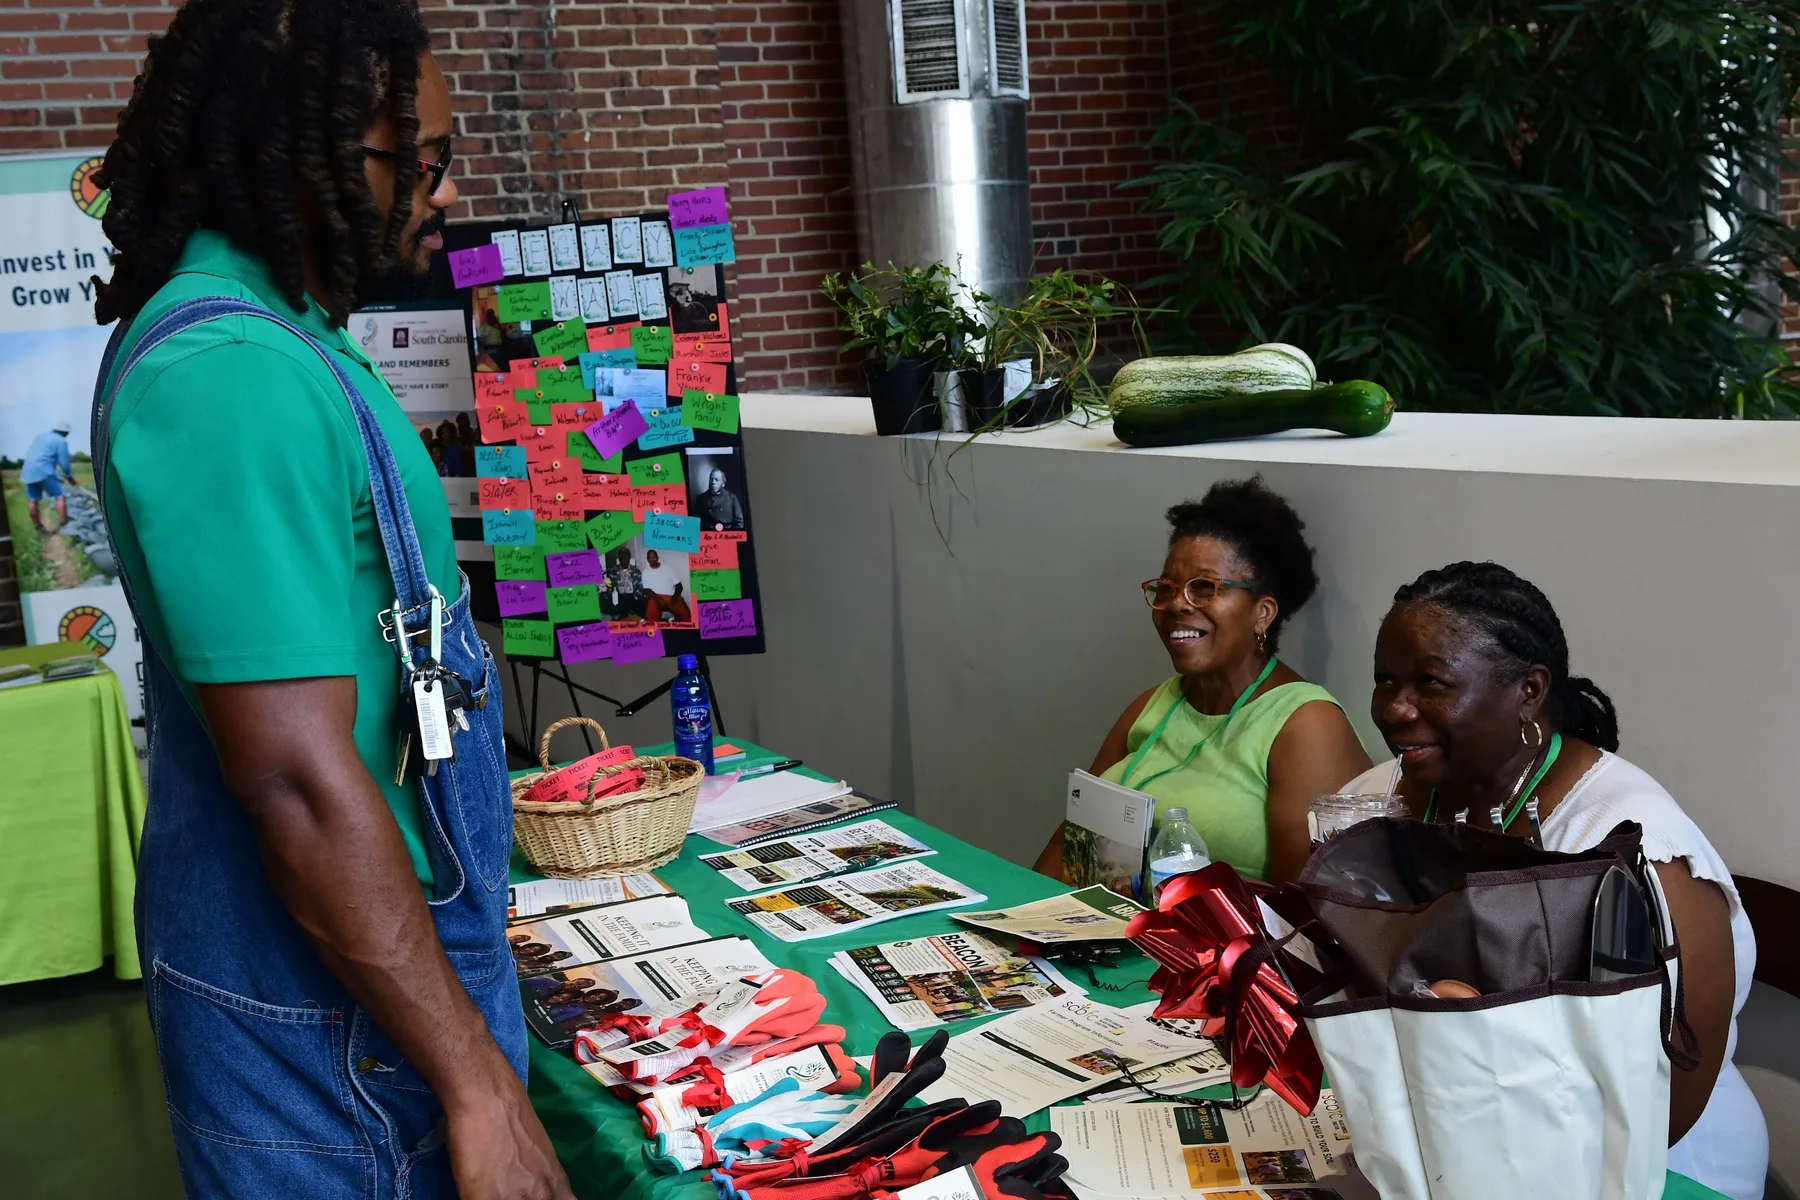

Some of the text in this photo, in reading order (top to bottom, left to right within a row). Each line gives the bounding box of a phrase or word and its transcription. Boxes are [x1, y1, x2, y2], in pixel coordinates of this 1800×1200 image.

[75, 248, 95, 268] in
[12, 286, 69, 306] Grow
[412, 332, 467, 345] South Carolin
[398, 359, 450, 368] REMEMBERS
[676, 369, 712, 384] Frankie
[692, 400, 728, 415] Wright
[694, 412, 722, 428] Family
[632, 488, 656, 496] Prince
[664, 497, 685, 510] Legree
[536, 507, 580, 520] Mary Legree
[678, 707, 708, 721] Callaway
[597, 752, 614, 762] TICKET
[568, 762, 588, 775] TICKET
[541, 776, 560, 790] TICKET
[614, 916, 643, 939] KEEPING
[605, 922, 621, 933] THE
[615, 933, 640, 953] FAMILY
[940, 934, 988, 968] BEACON
[673, 964, 692, 976] THE
[683, 957, 717, 985] KEEPING
[1048, 1009, 1124, 1047] Farmer Program Information
[1312, 1125, 1324, 1139] BUILD
[1318, 1139, 1329, 1153] YOUR
[1207, 1149, 1220, 1164] $250
[1323, 1153, 1335, 1165] SOIL
